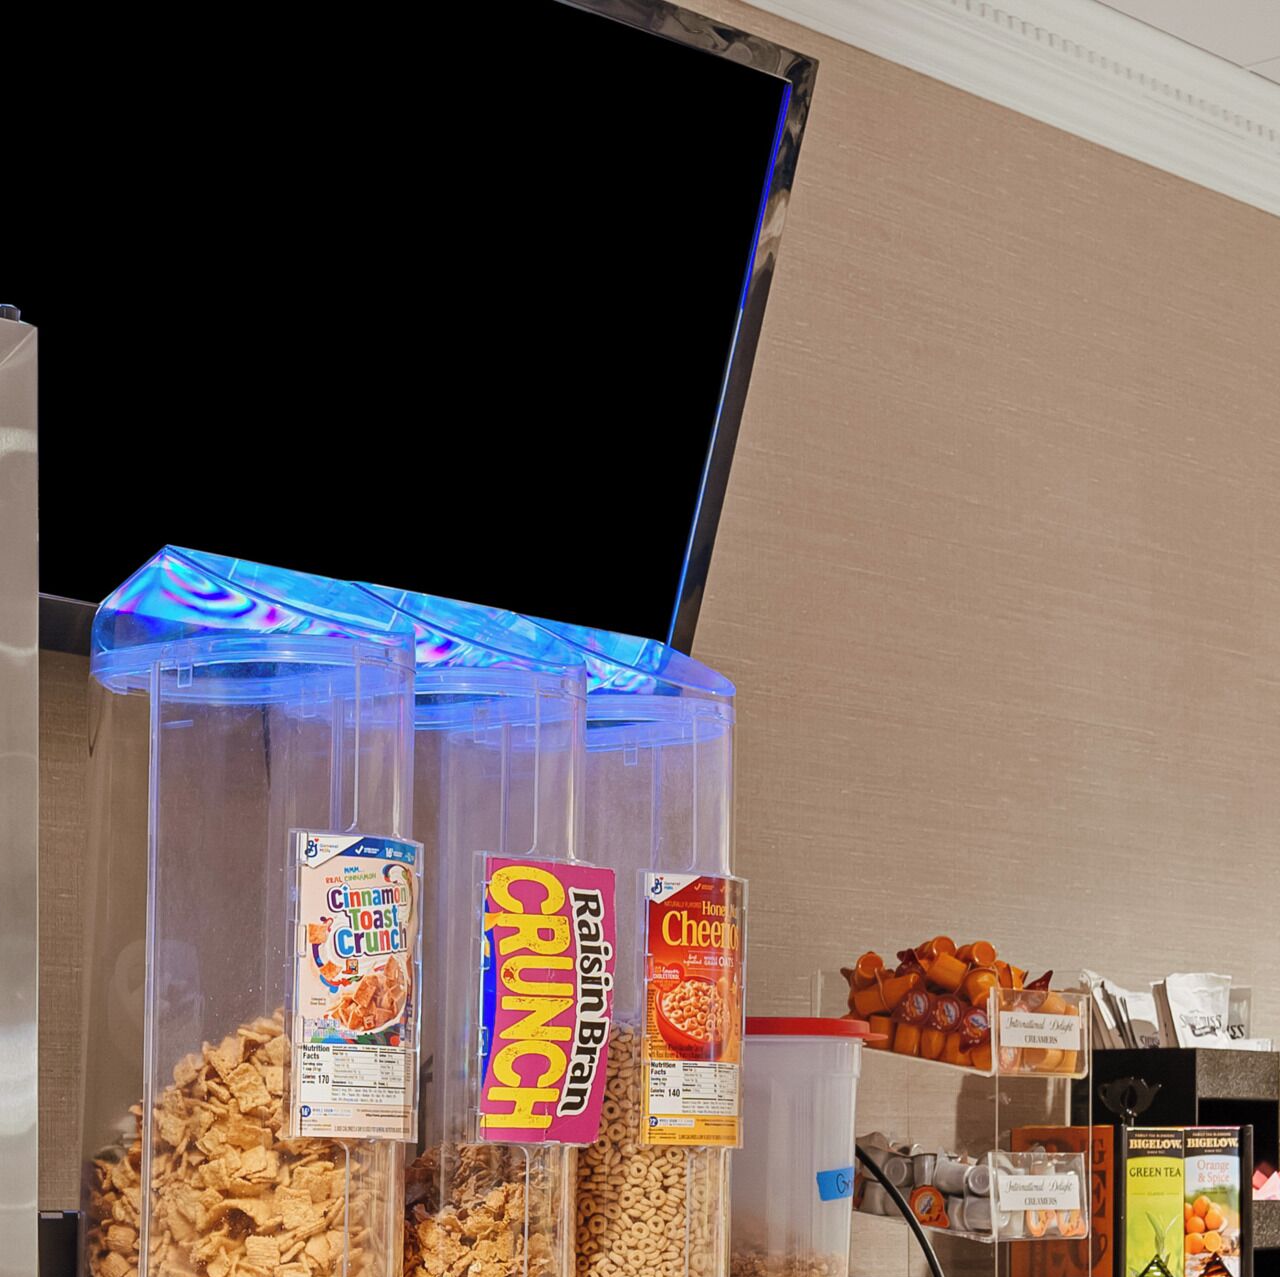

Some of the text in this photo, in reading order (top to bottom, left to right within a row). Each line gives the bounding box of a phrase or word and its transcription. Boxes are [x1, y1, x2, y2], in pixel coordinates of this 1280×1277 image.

[330, 886, 406, 909] Cinnamon
[702, 901, 728, 916] Hone
[349, 905, 398, 930] Toast
[662, 911, 738, 950] Cheerio
[337, 922, 407, 955] Crunch
[481, 865, 574, 1129] CRUNCH
[559, 889, 611, 1114] Raisin Bran
[1025, 1035, 1057, 1043] CREAMERS
[319, 1075, 329, 1084] 170
[668, 1089, 680, 1097] 140
[1197, 1160, 1229, 1171] Orange
[1130, 1168, 1181, 1177] GREEN TEA
[1199, 1172, 1229, 1184] & Spice
[1025, 1197, 1056, 1205] CREAMERS
